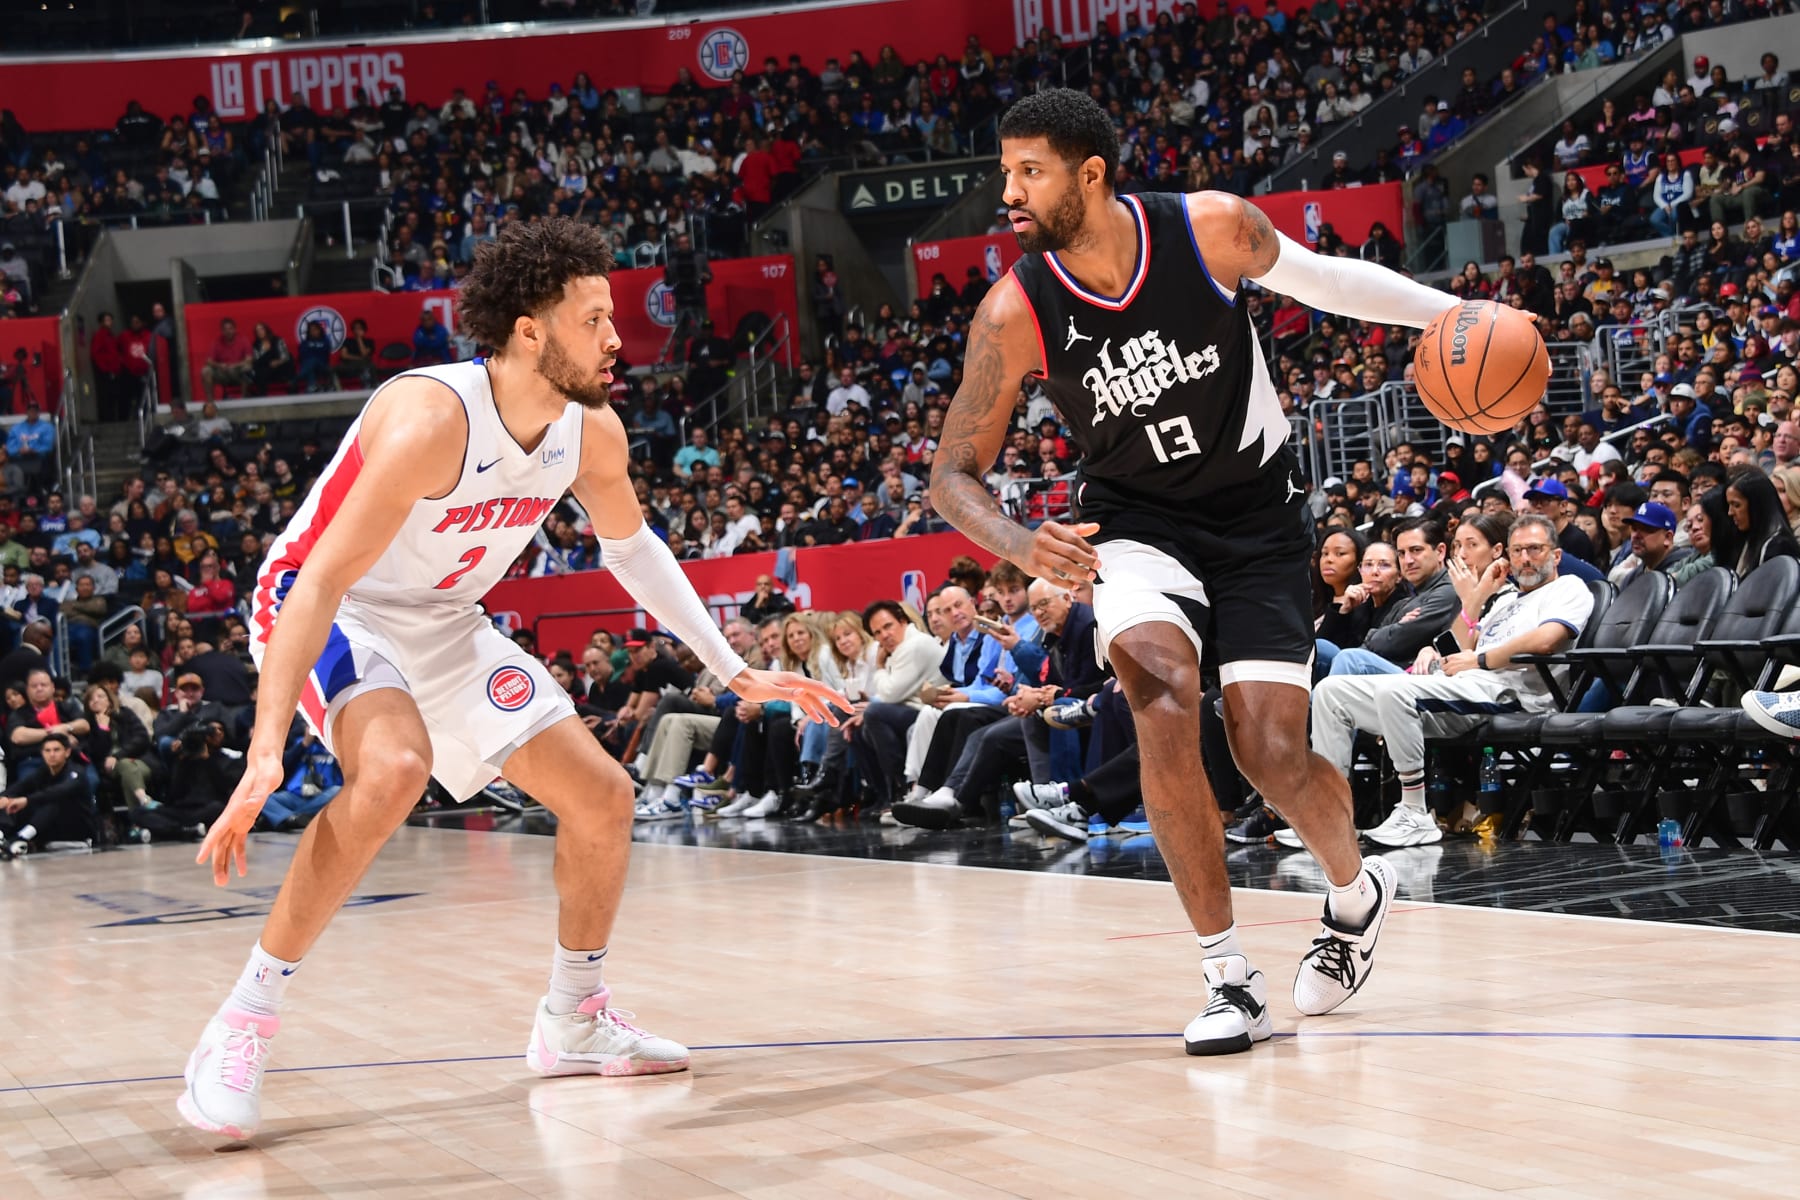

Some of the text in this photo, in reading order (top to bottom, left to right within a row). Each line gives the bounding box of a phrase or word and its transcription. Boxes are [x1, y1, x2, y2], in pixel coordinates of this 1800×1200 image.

[210, 52, 406, 116] LA CLIPPERS
[884, 172, 986, 203] DELT
[762, 264, 787, 278] 107
[917, 245, 939, 260] 108
[1097, 329, 1168, 384] Los
[1082, 340, 1220, 427] Angeles
[1144, 415, 1201, 463] 13
[432, 546, 487, 589] 2
[495, 675, 522, 694] DETROIT
[500, 682, 527, 702] PISTONS
